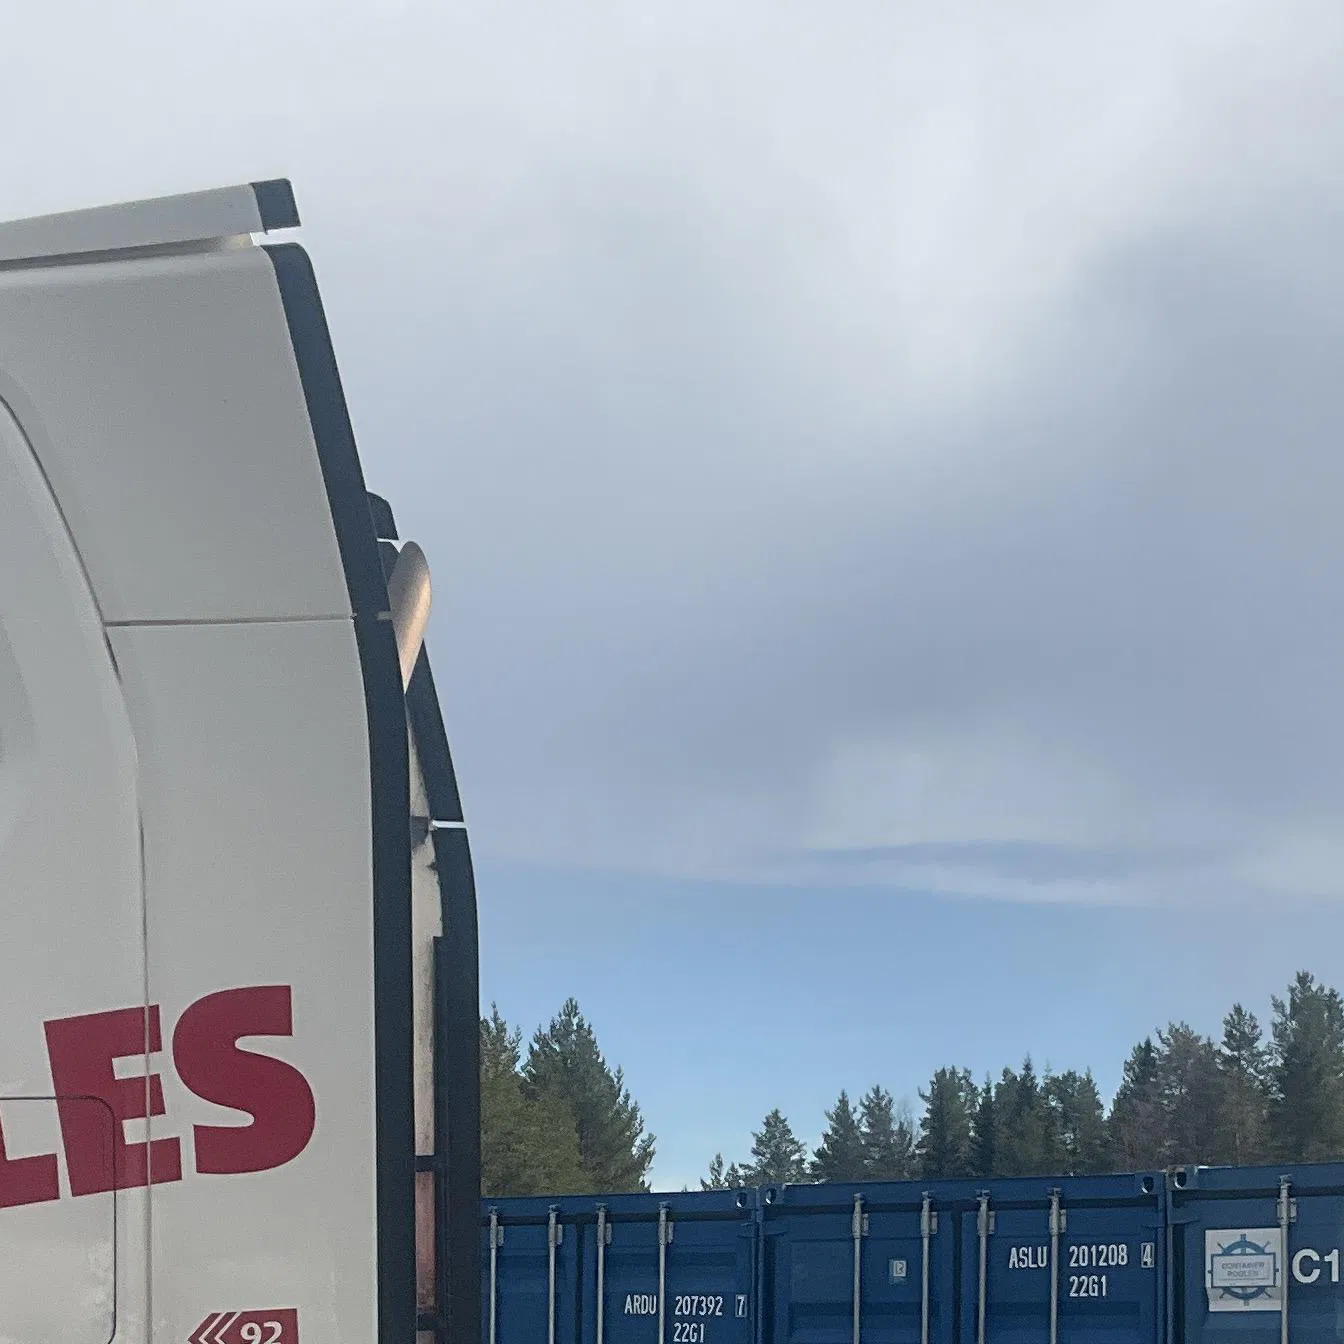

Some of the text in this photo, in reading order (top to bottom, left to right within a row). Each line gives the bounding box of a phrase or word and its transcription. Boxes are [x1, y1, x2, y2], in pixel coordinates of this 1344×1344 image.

[1008, 1243, 1154, 1268] ASLU 201208 4
[1069, 1275, 1106, 1297] 22G1
[624, 1295, 747, 1317] ARDU 207392 7
[673, 1323, 704, 1342] 22G1
